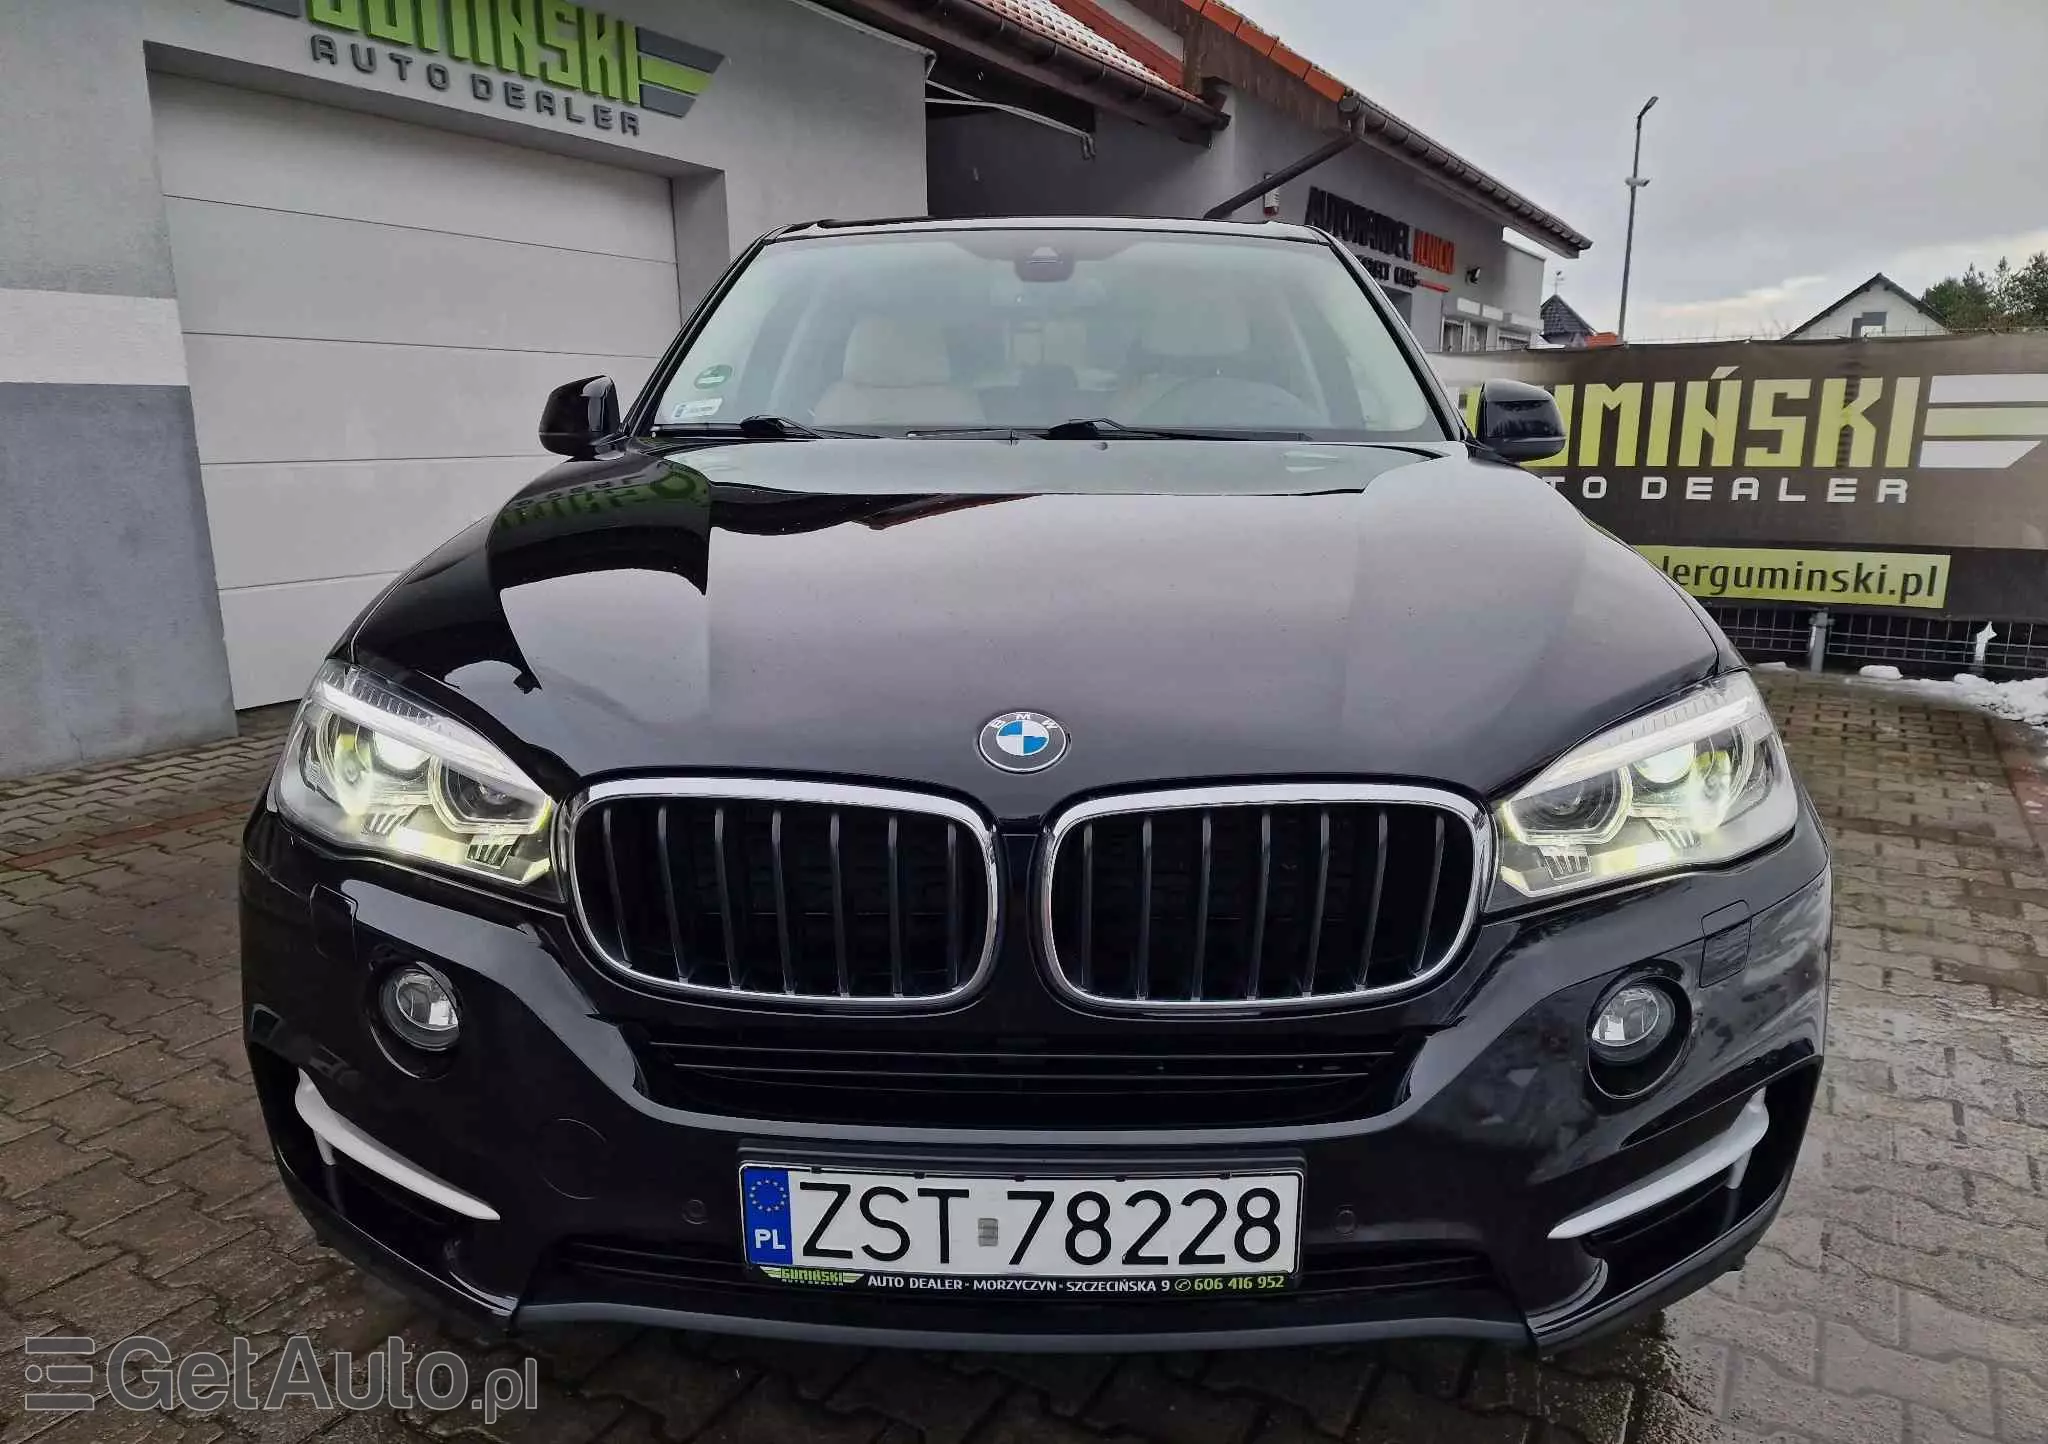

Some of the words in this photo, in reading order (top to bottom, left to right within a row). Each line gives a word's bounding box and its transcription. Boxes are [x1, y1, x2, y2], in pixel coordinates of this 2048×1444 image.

[310, 34, 450, 91] AUTO
[471, 73, 640, 137] DEALER
[1641, 477, 1908, 503] DEALER
[800, 1181, 970, 1264] ZST
[1007, 1187, 1281, 1266] 78228
[755, 1229, 786, 1251] PL
[868, 1275, 904, 1288] AUTO
[910, 1276, 962, 1290] DEALER
[973, 1279, 1057, 1292] MORZYCZYN
[1066, 1278, 1157, 1292] SZCZECIŃSKA
[1161, 1280, 1170, 1291] 9
[1194, 1278, 1224, 1291] 606
[1228, 1277, 1253, 1290] 416
[1258, 1275, 1285, 1289] 952
